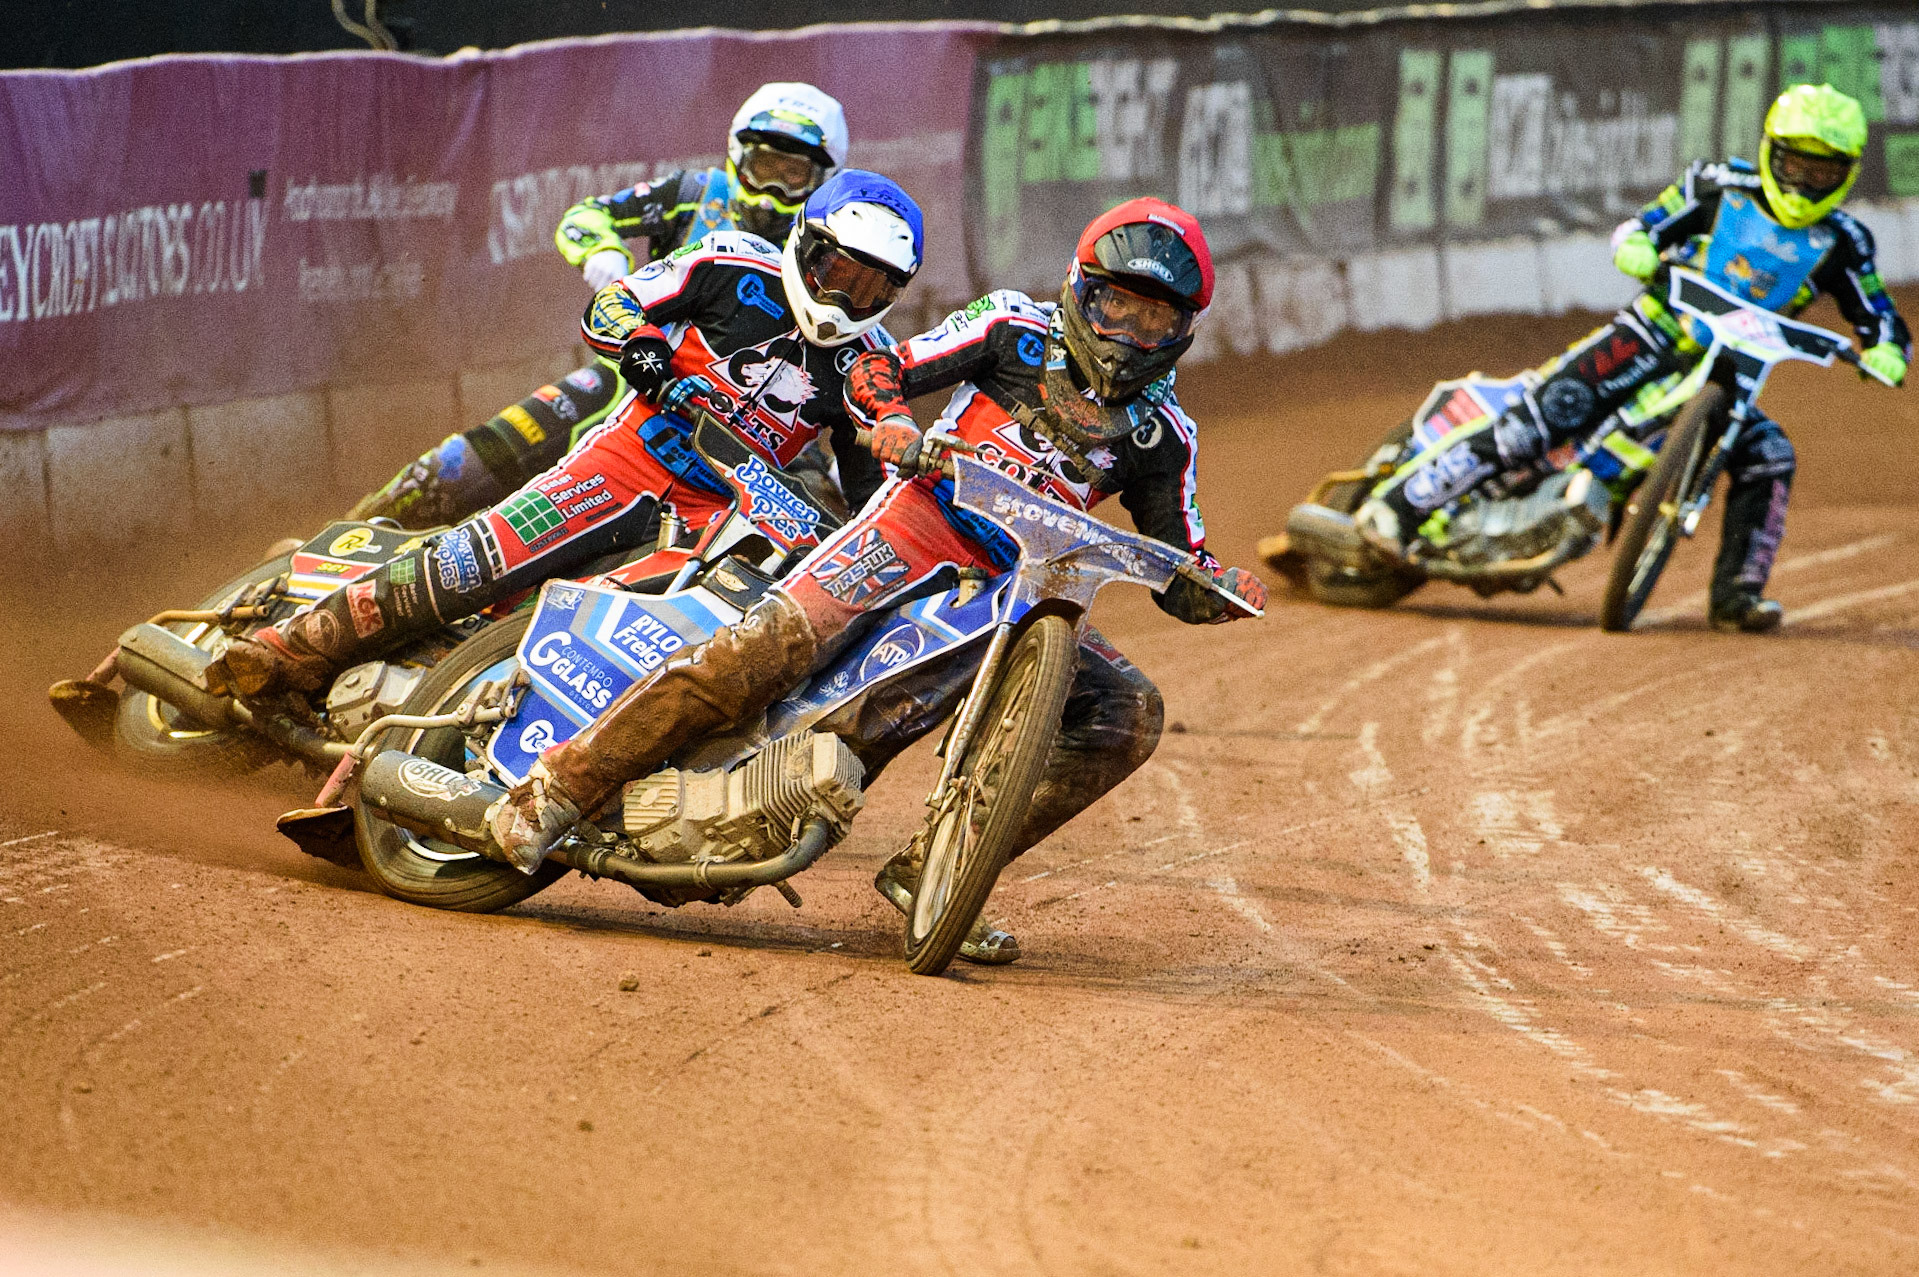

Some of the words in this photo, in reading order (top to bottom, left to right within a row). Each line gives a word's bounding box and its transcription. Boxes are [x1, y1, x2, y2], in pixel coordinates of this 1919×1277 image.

[549, 473, 606, 505] Services
[562, 489, 613, 519] Limited
[630, 614, 683, 653] RYLO
[551, 657, 613, 709] GLASS
[562, 646, 613, 688] CONTEMPO
